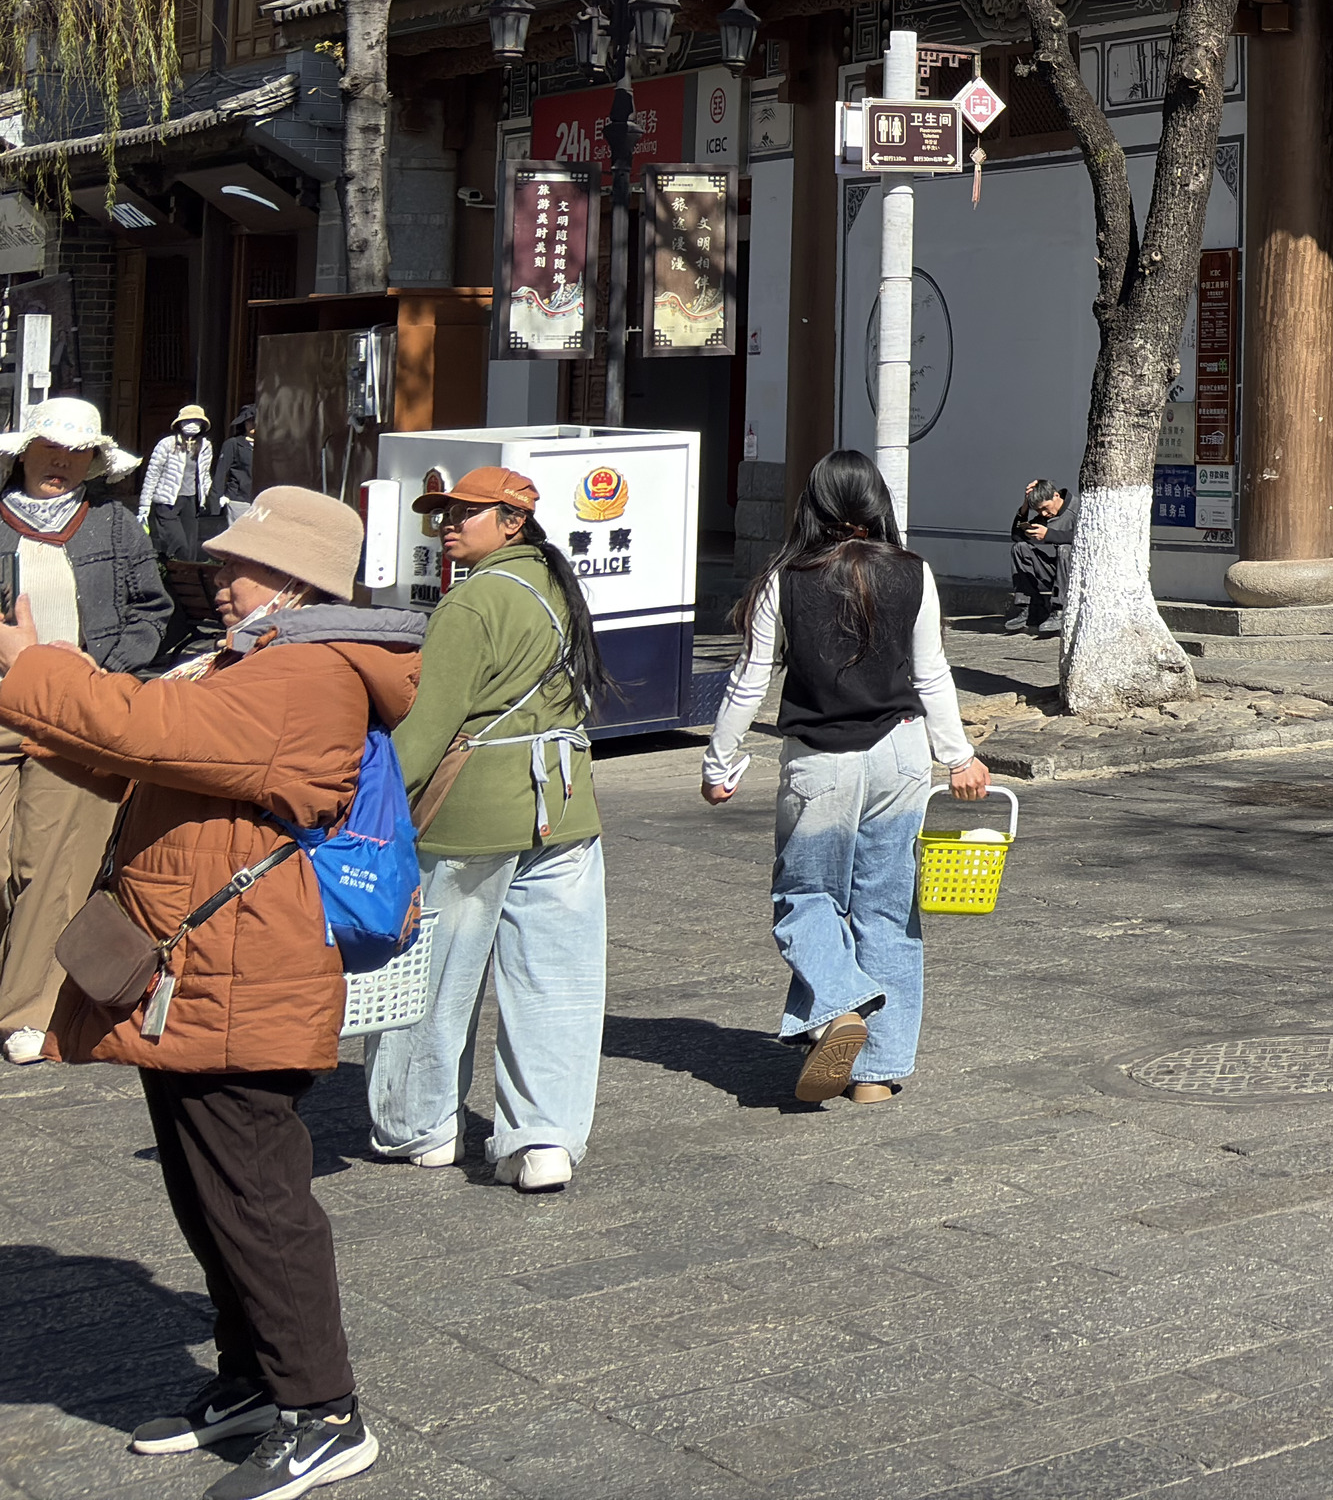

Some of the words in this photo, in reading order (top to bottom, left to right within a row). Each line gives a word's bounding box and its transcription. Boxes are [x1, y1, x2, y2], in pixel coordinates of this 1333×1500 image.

[910, 112, 952, 128] 卫生间
[555, 121, 591, 162] 24h
[706, 136, 728, 154] ICBC
[534, 184, 550, 269] 旅游美时美刻
[553, 200, 570, 285] 文明随时随地
[671, 197, 689, 272] 旅途漫漫
[695, 217, 712, 291] 文明相伴
[1155, 484, 1192, 498] 社银合作
[1159, 503, 1186, 518] 服务点
[568, 528, 633, 556] 警察
